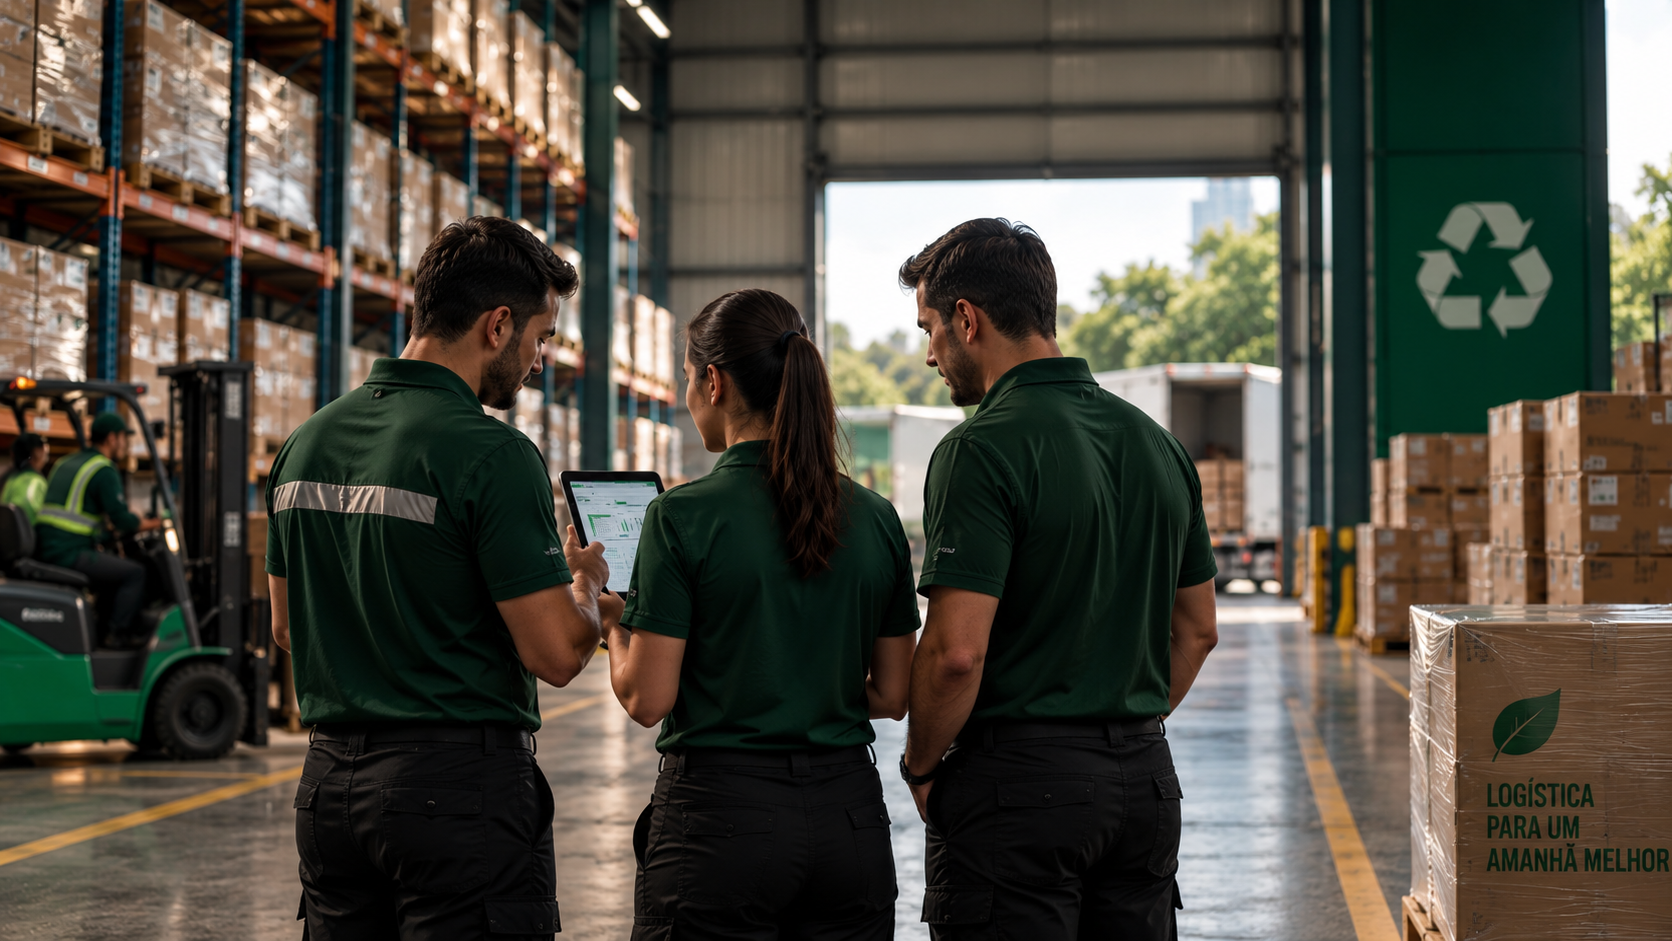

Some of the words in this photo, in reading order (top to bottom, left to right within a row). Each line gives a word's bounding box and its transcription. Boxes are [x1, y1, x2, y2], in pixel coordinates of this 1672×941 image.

[1487, 777, 1594, 808] LOGÍSTICA
[1487, 815, 1542, 839] PARA
[1548, 815, 1580, 839] UM
[1584, 848, 1670, 872] MELHOR
